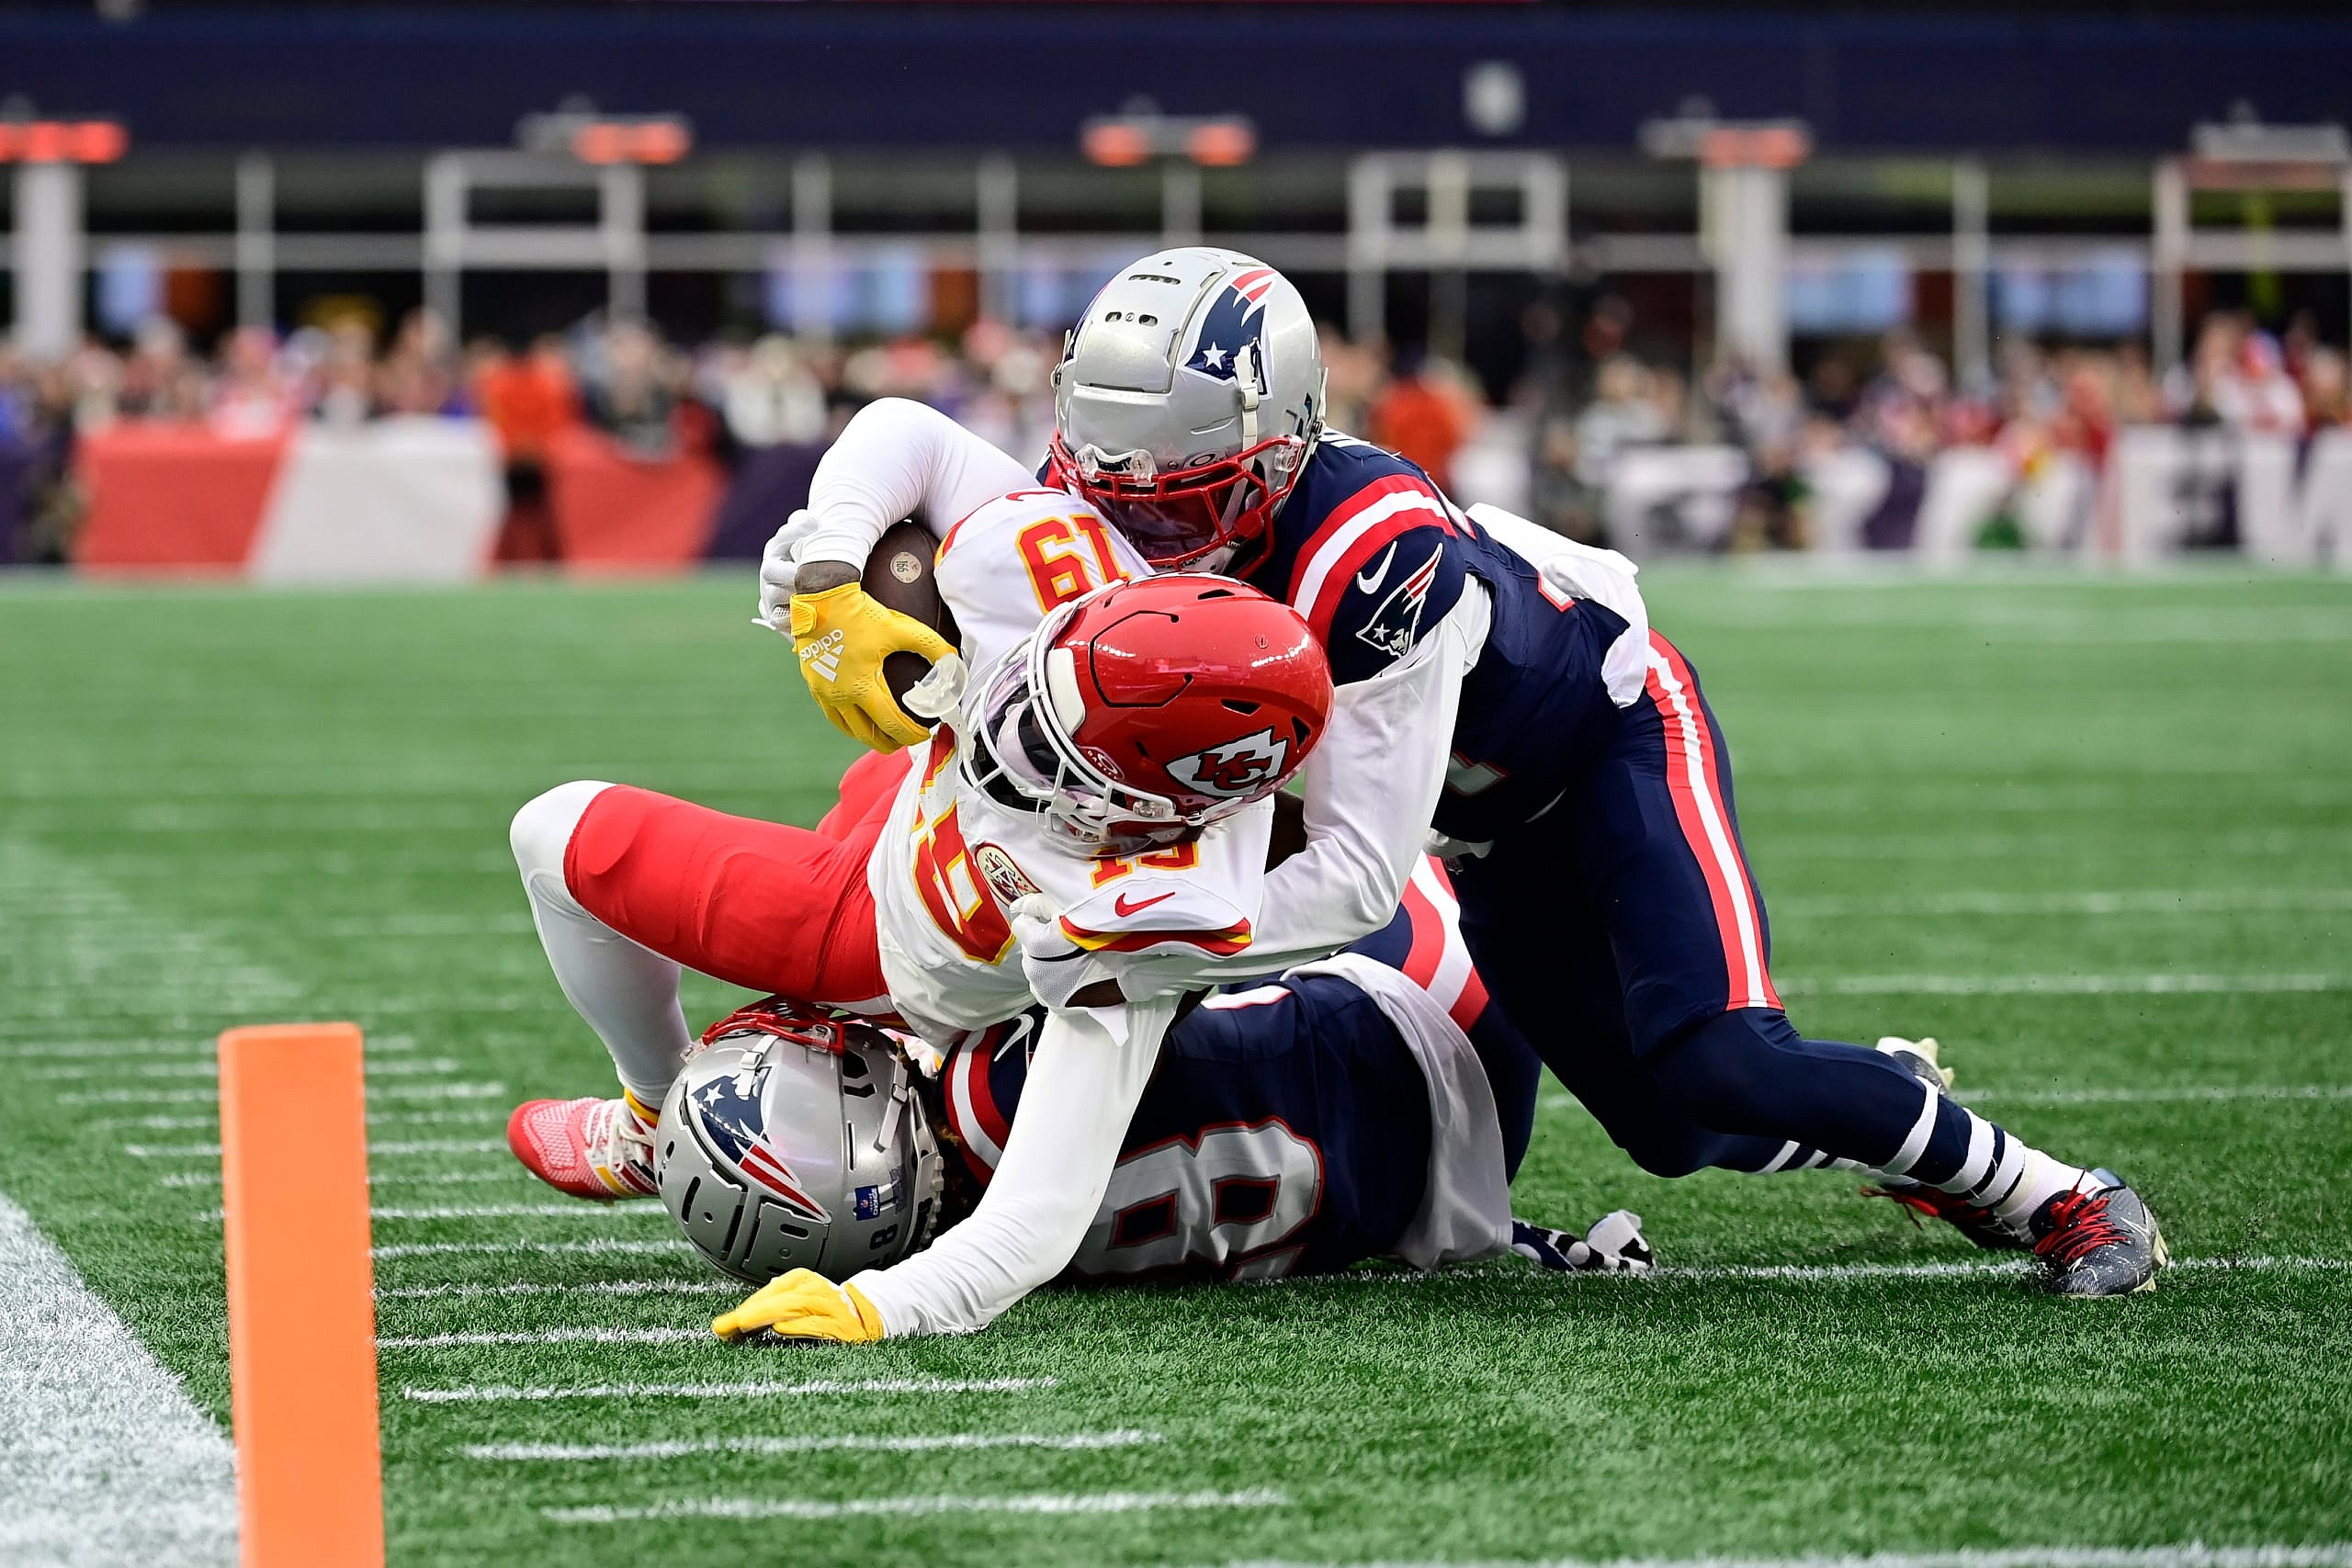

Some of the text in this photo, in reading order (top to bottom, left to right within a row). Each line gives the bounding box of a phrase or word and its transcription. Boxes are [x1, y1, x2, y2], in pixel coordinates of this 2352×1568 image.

[1015, 514, 1132, 615] 19
[800, 629, 843, 661] adidas
[1192, 750, 1272, 791] KC
[1070, 1114, 1325, 1284] 8
